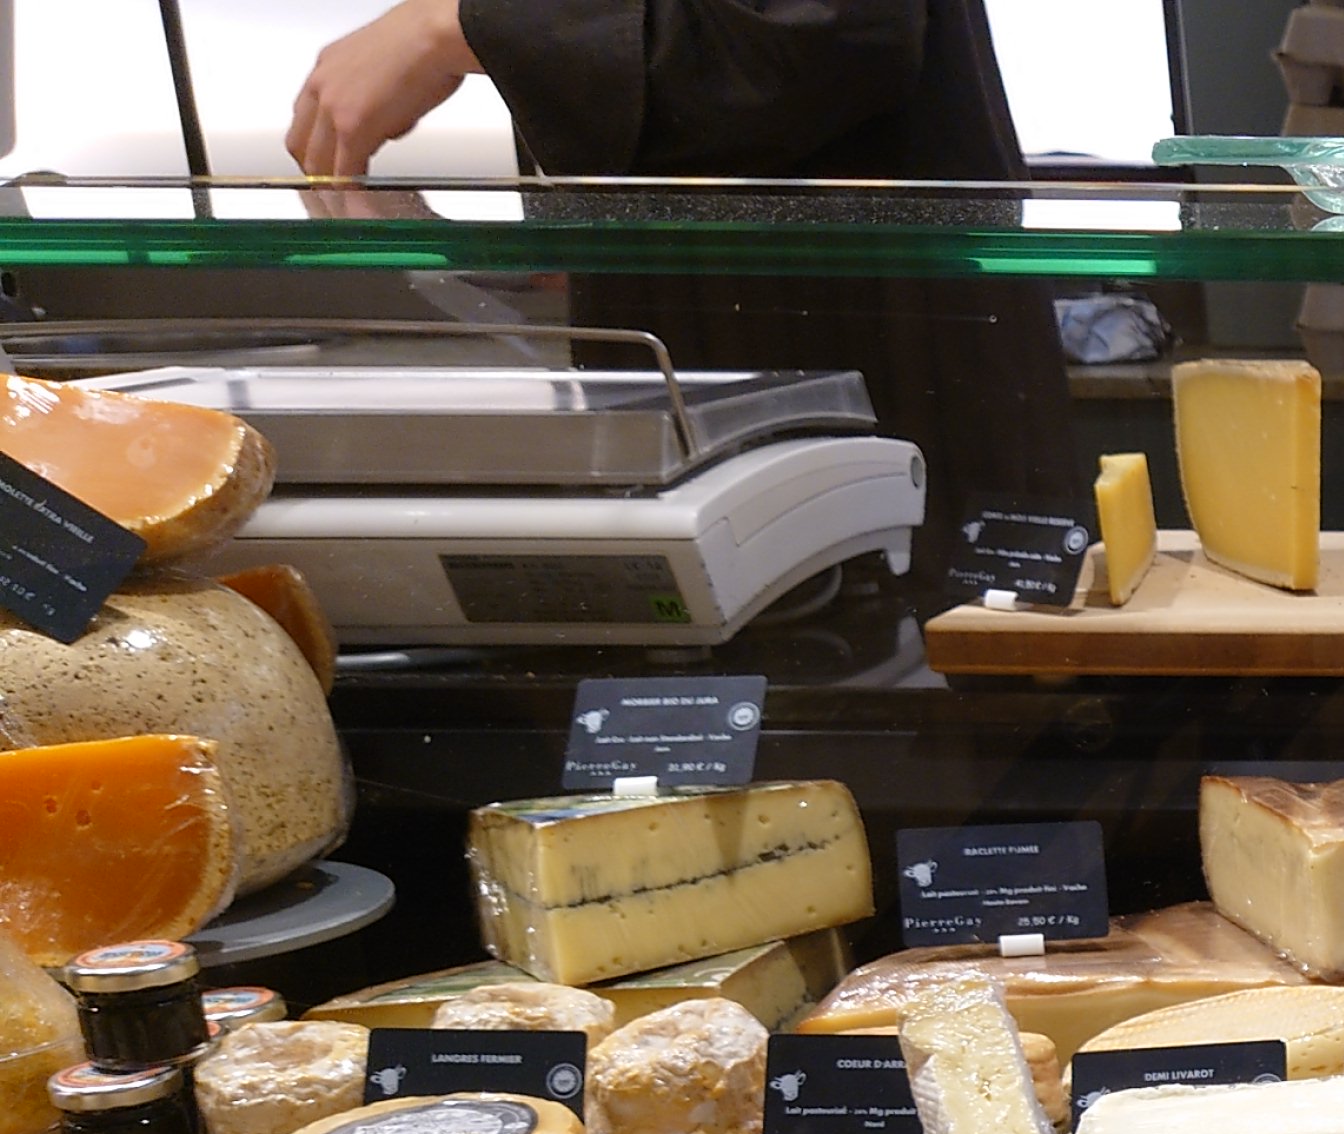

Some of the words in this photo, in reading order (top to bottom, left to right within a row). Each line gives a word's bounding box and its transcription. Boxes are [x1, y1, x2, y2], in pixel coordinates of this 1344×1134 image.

[964, 847, 1006, 855] RACLETTE
[837, 1060, 871, 1068] COEUR
[1145, 1073, 1169, 1081] DEMI
[1172, 1069, 1213, 1080] LIVAROT
